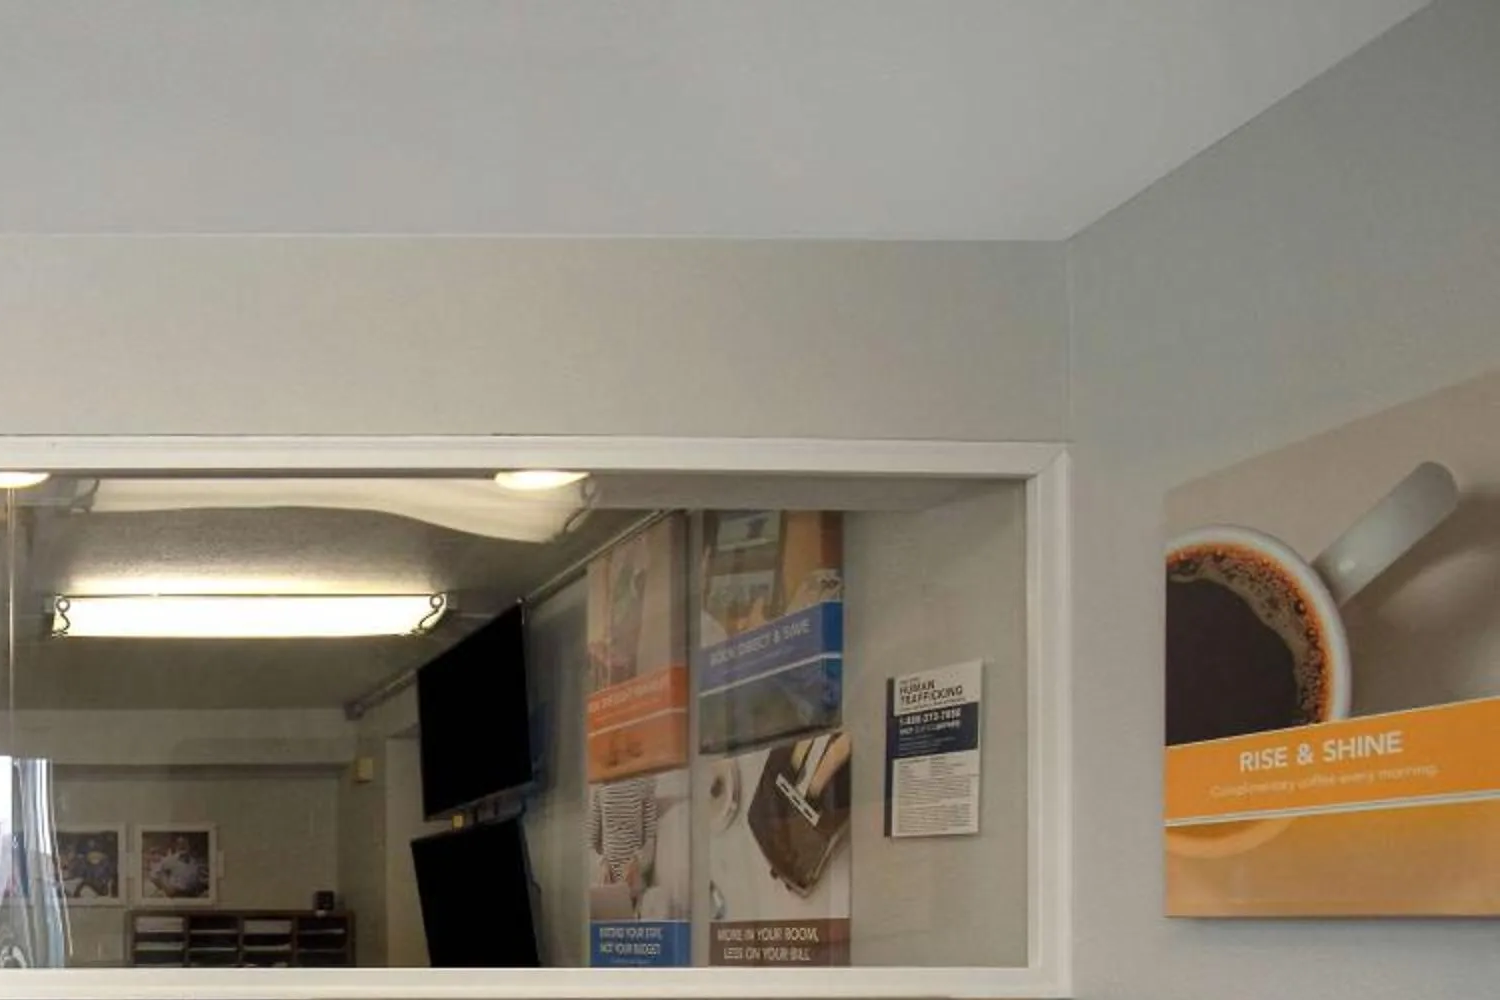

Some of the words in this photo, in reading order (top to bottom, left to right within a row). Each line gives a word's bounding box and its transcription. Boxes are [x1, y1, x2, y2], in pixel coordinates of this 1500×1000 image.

[782, 617, 811, 640] SAVE
[1239, 746, 1288, 773] RISE
[1296, 743, 1314, 766] &
[1322, 730, 1405, 763] SHINE
[717, 929, 742, 941] MORE
[757, 927, 783, 941] YOUR
[762, 947, 789, 961] YOUR
